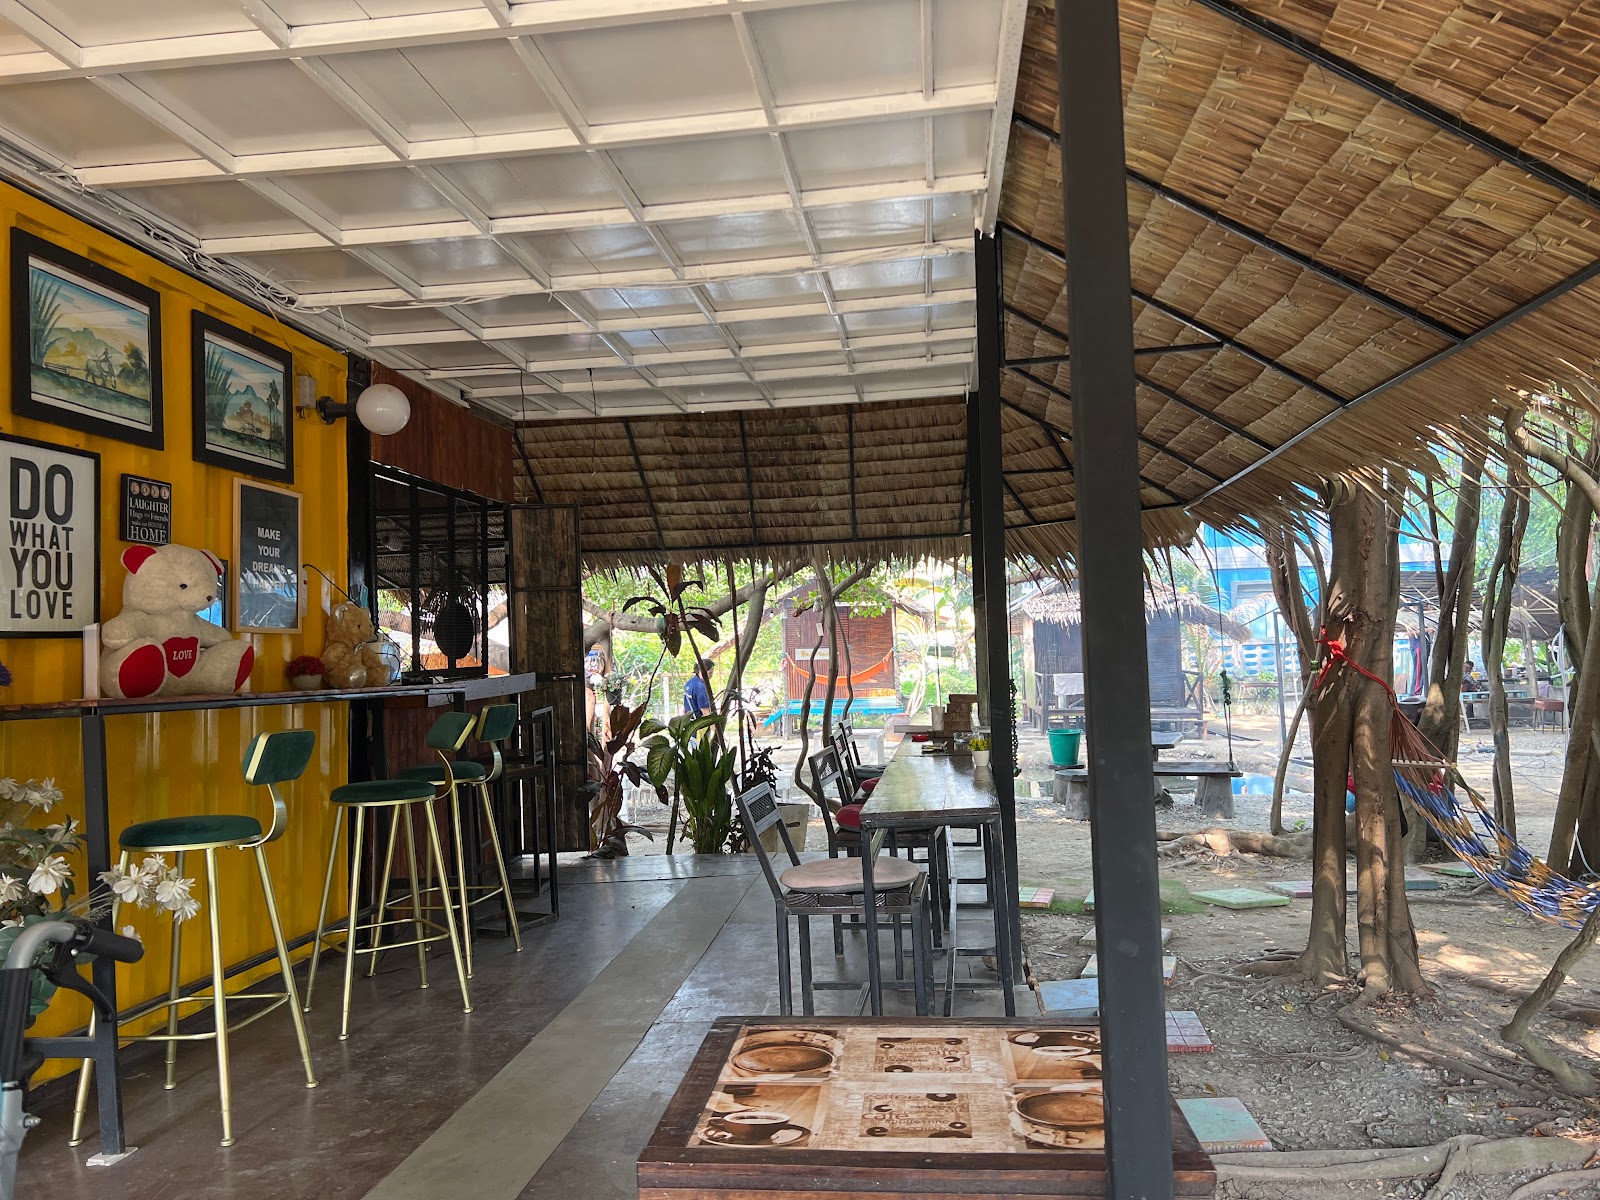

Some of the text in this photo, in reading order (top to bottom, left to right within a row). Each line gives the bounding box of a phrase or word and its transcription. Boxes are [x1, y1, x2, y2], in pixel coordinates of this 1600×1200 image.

[10, 456, 74, 525] DO
[129, 497, 169, 513] LAUGHTER
[9, 520, 74, 551] WHAT
[130, 526, 167, 543] HOME
[257, 526, 281, 541] MAKE
[257, 545, 280, 558] YOUR
[9, 547, 74, 590] YOU
[10, 589, 74, 620] LOVE
[172, 649, 193, 660] LOVE
[865, 1092, 921, 1100] coffee
[862, 1110, 909, 1120] cafe
